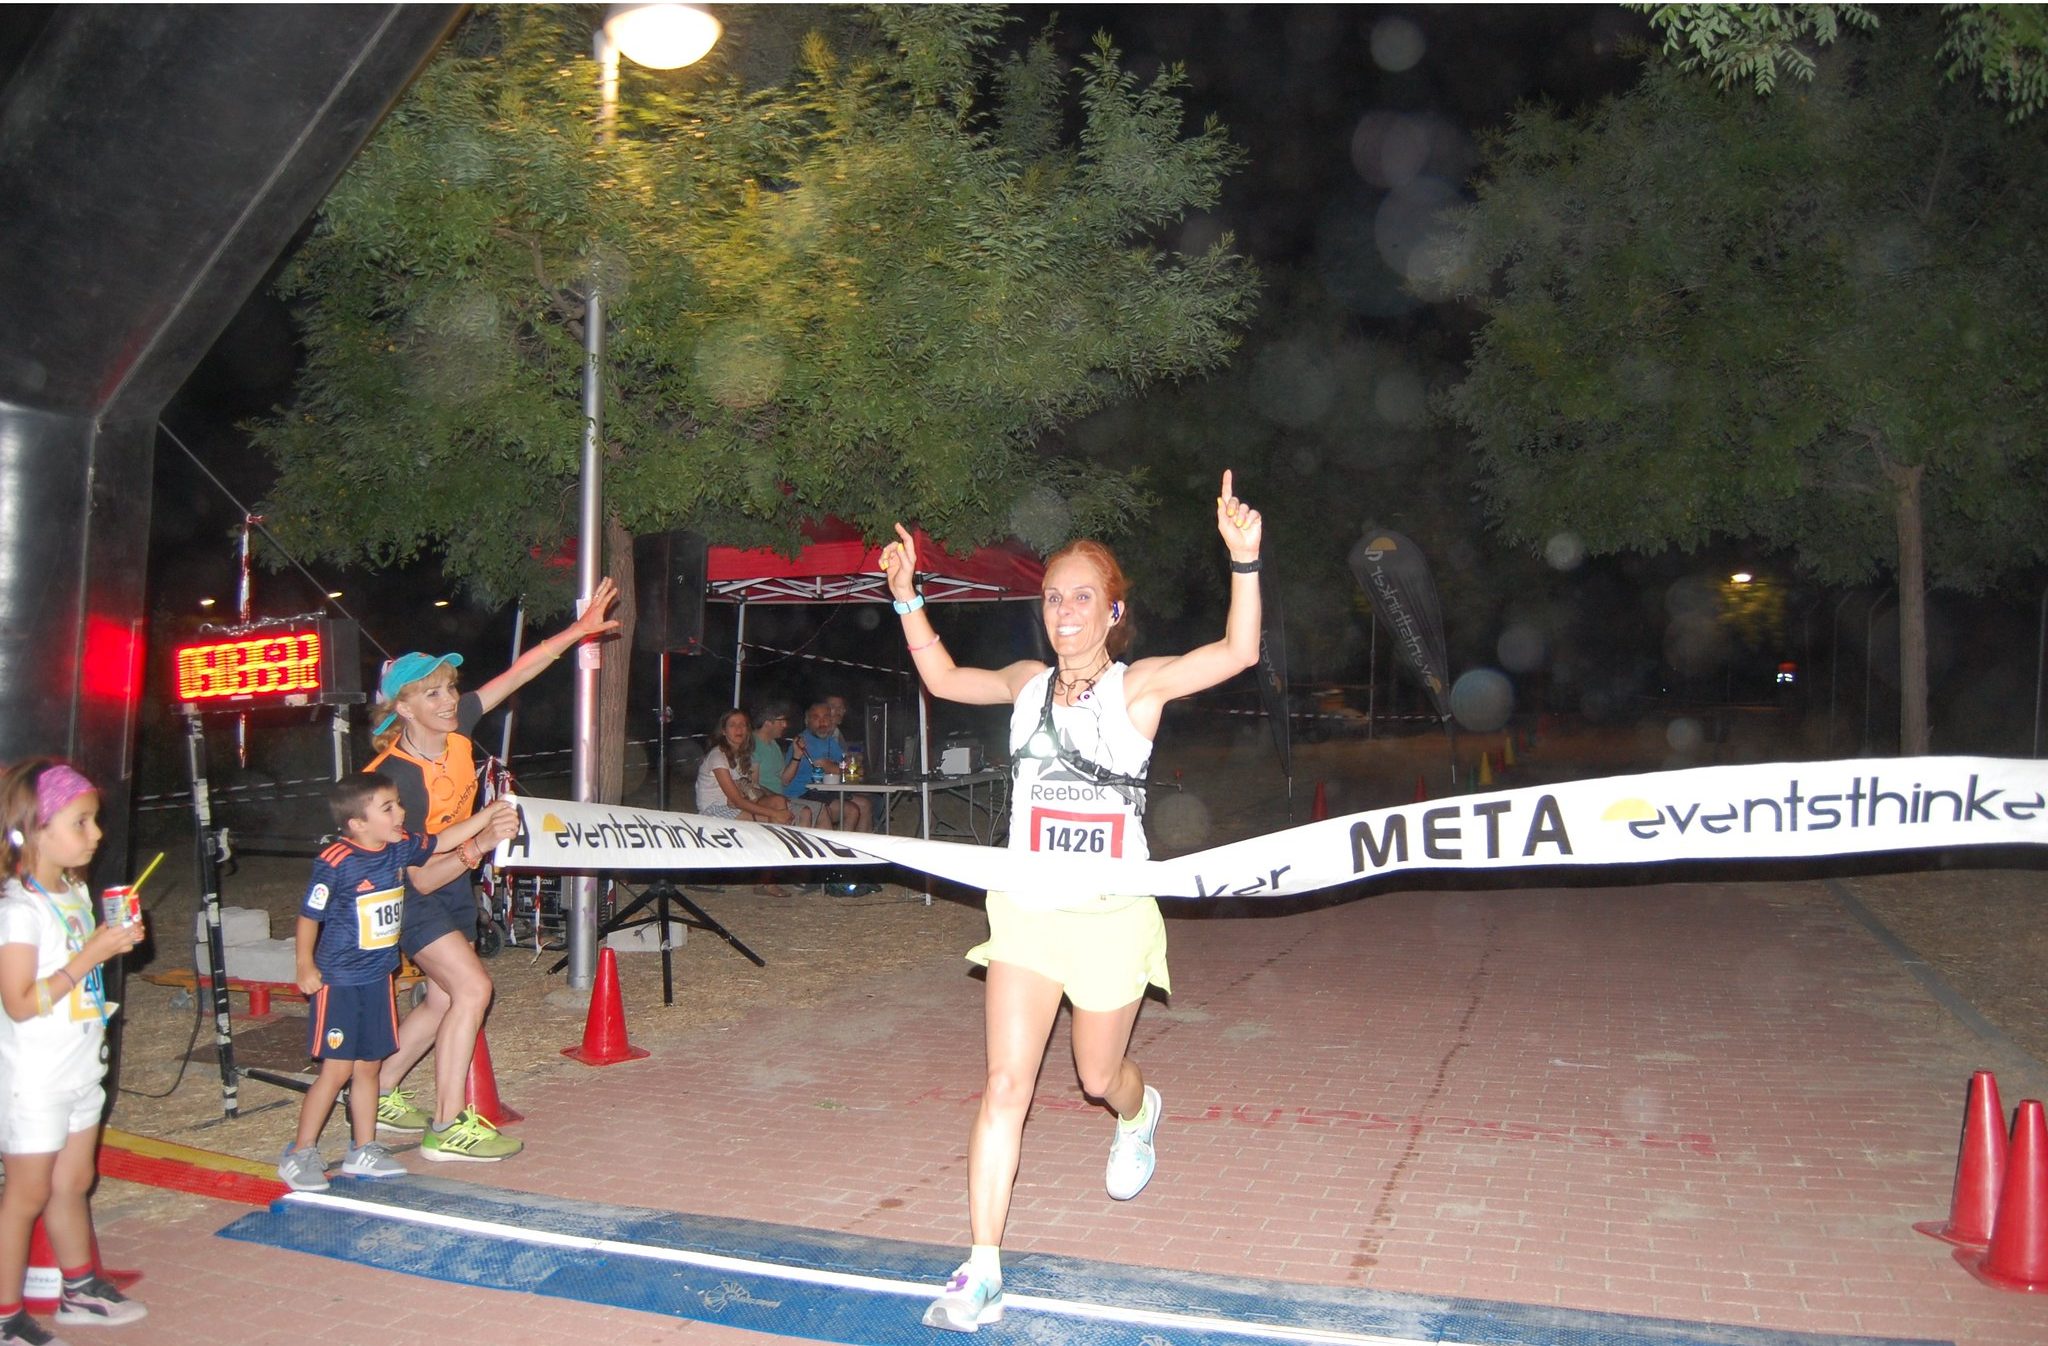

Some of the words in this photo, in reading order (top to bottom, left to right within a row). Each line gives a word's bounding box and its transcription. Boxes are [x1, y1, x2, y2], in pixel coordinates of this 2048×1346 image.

[1031, 784, 1107, 801] Reebok
[507, 803, 530, 858] A
[555, 812, 743, 849] eventsthinker
[1349, 794, 1573, 874] META
[1628, 774, 2046, 839] eventsthinke
[1046, 825, 1105, 853] 1426
[375, 901, 402, 927] 189
